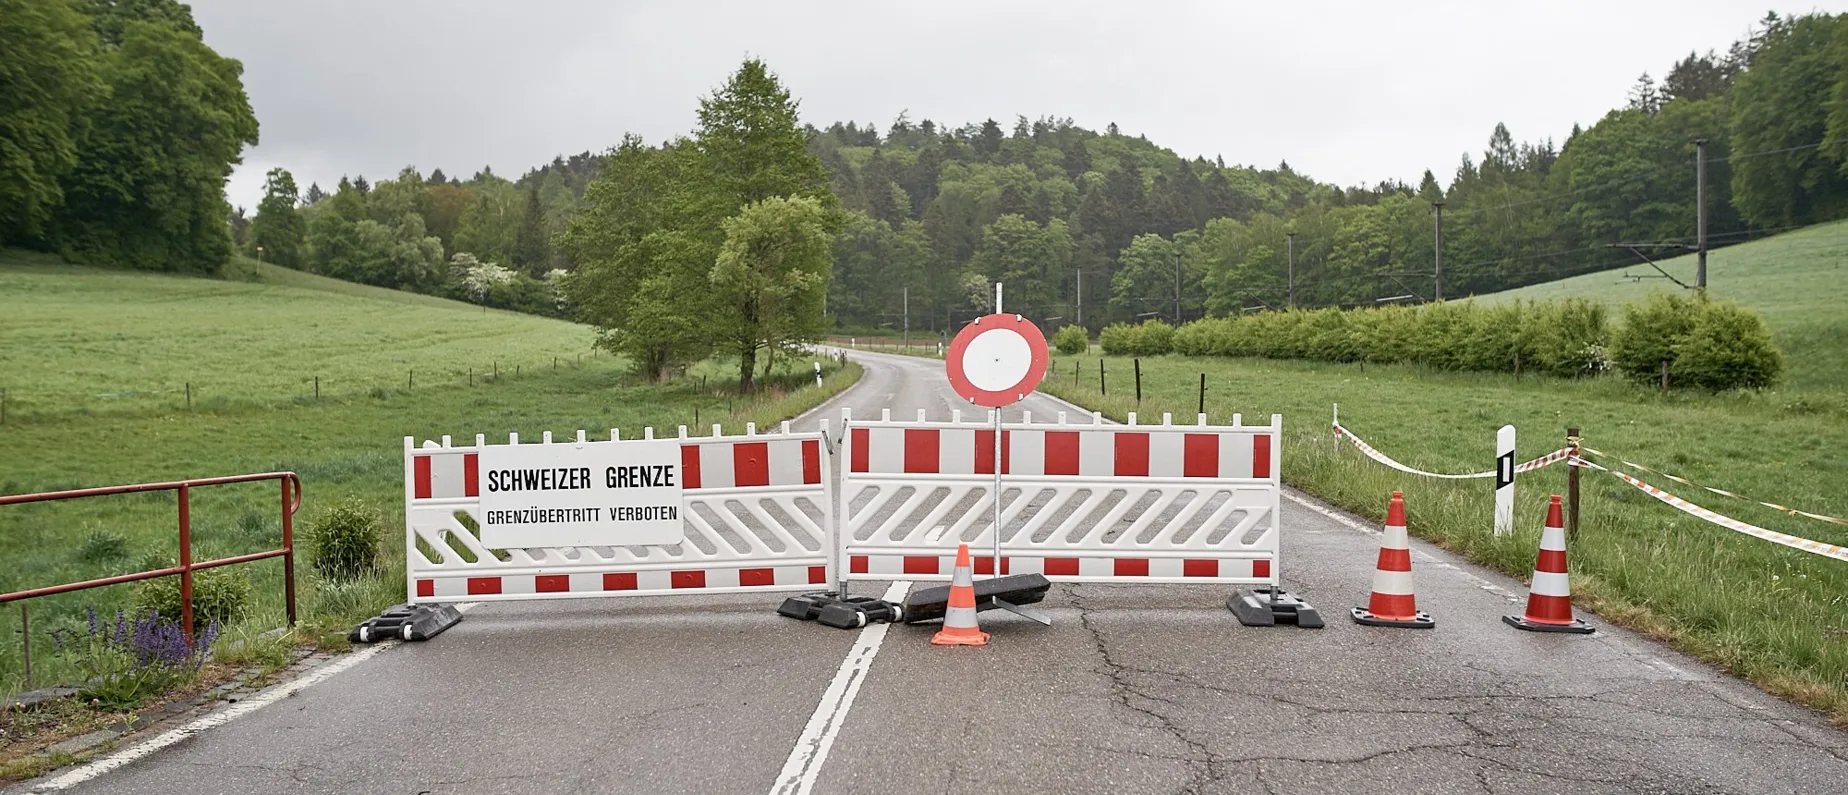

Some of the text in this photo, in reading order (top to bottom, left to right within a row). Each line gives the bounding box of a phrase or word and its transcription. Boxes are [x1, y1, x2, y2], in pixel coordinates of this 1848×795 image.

[488, 465, 675, 492] SCHWEIZER GRENZE
[487, 505, 677, 524] GRENZÜBERTRITT VERBOTEN
